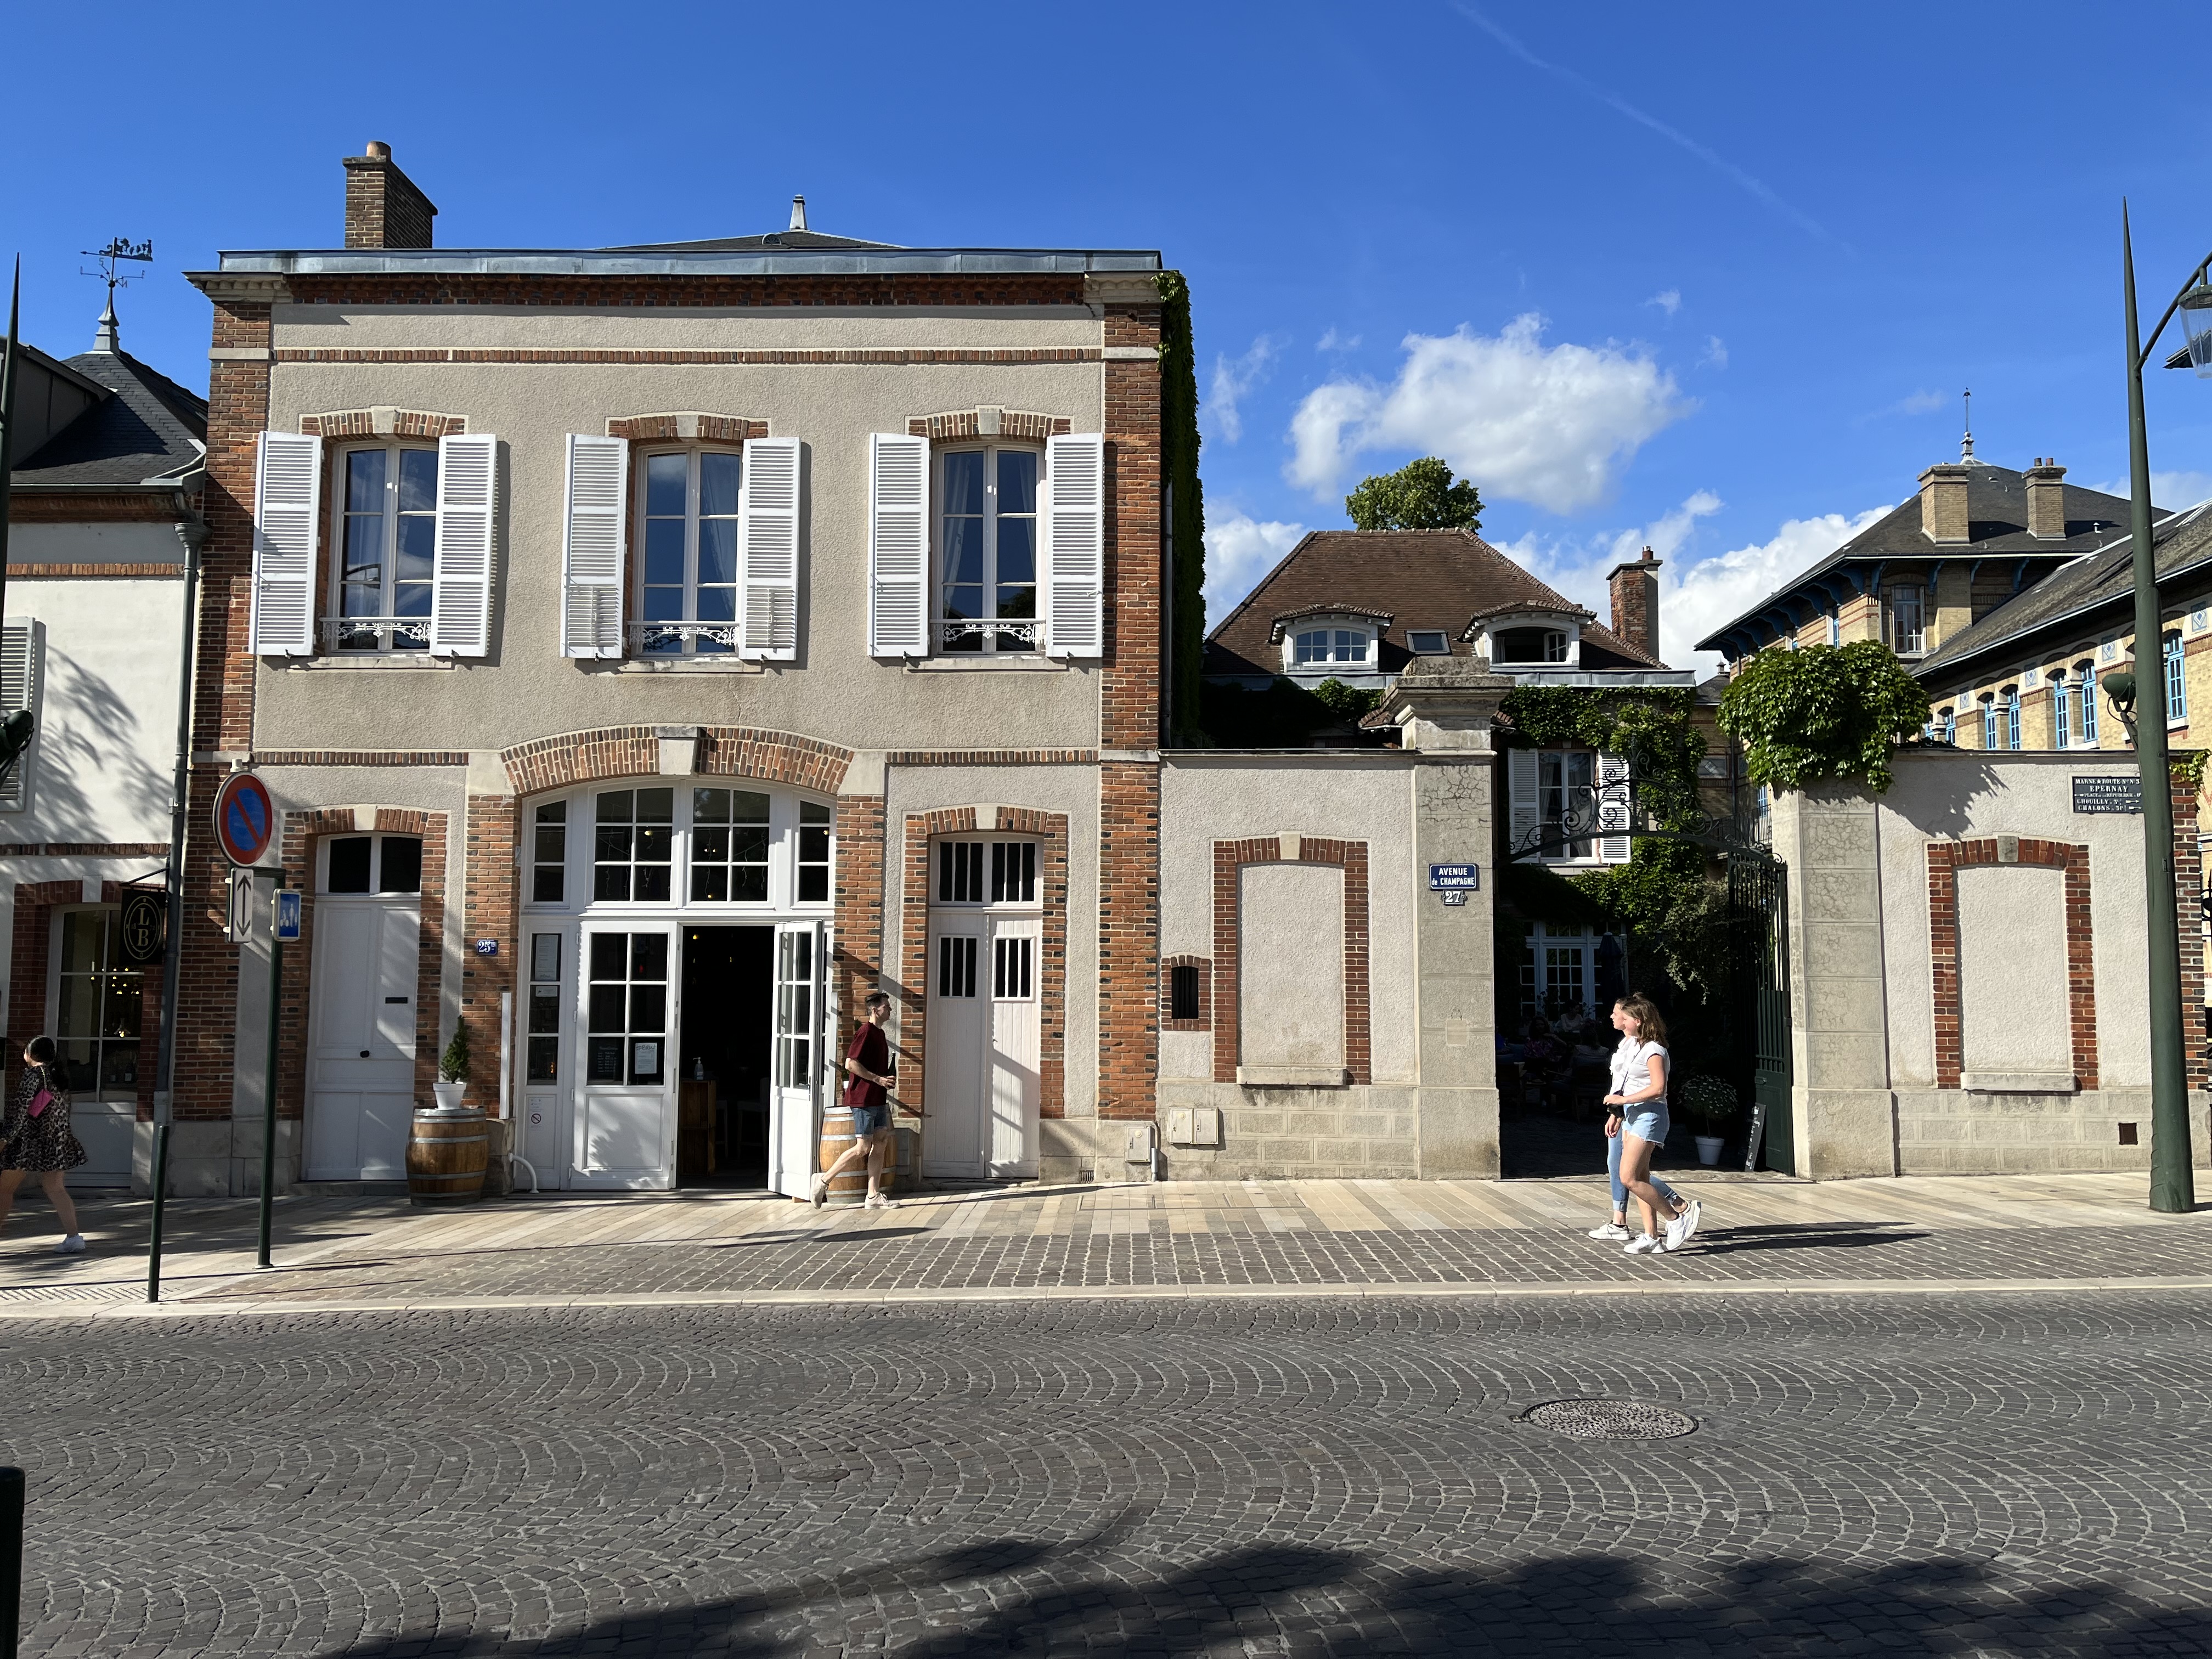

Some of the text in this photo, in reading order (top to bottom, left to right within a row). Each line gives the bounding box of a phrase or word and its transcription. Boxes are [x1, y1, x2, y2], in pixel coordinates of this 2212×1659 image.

[1445, 891, 1461, 902] 27
[138, 908, 149, 925] L
[136, 929, 149, 946] B
